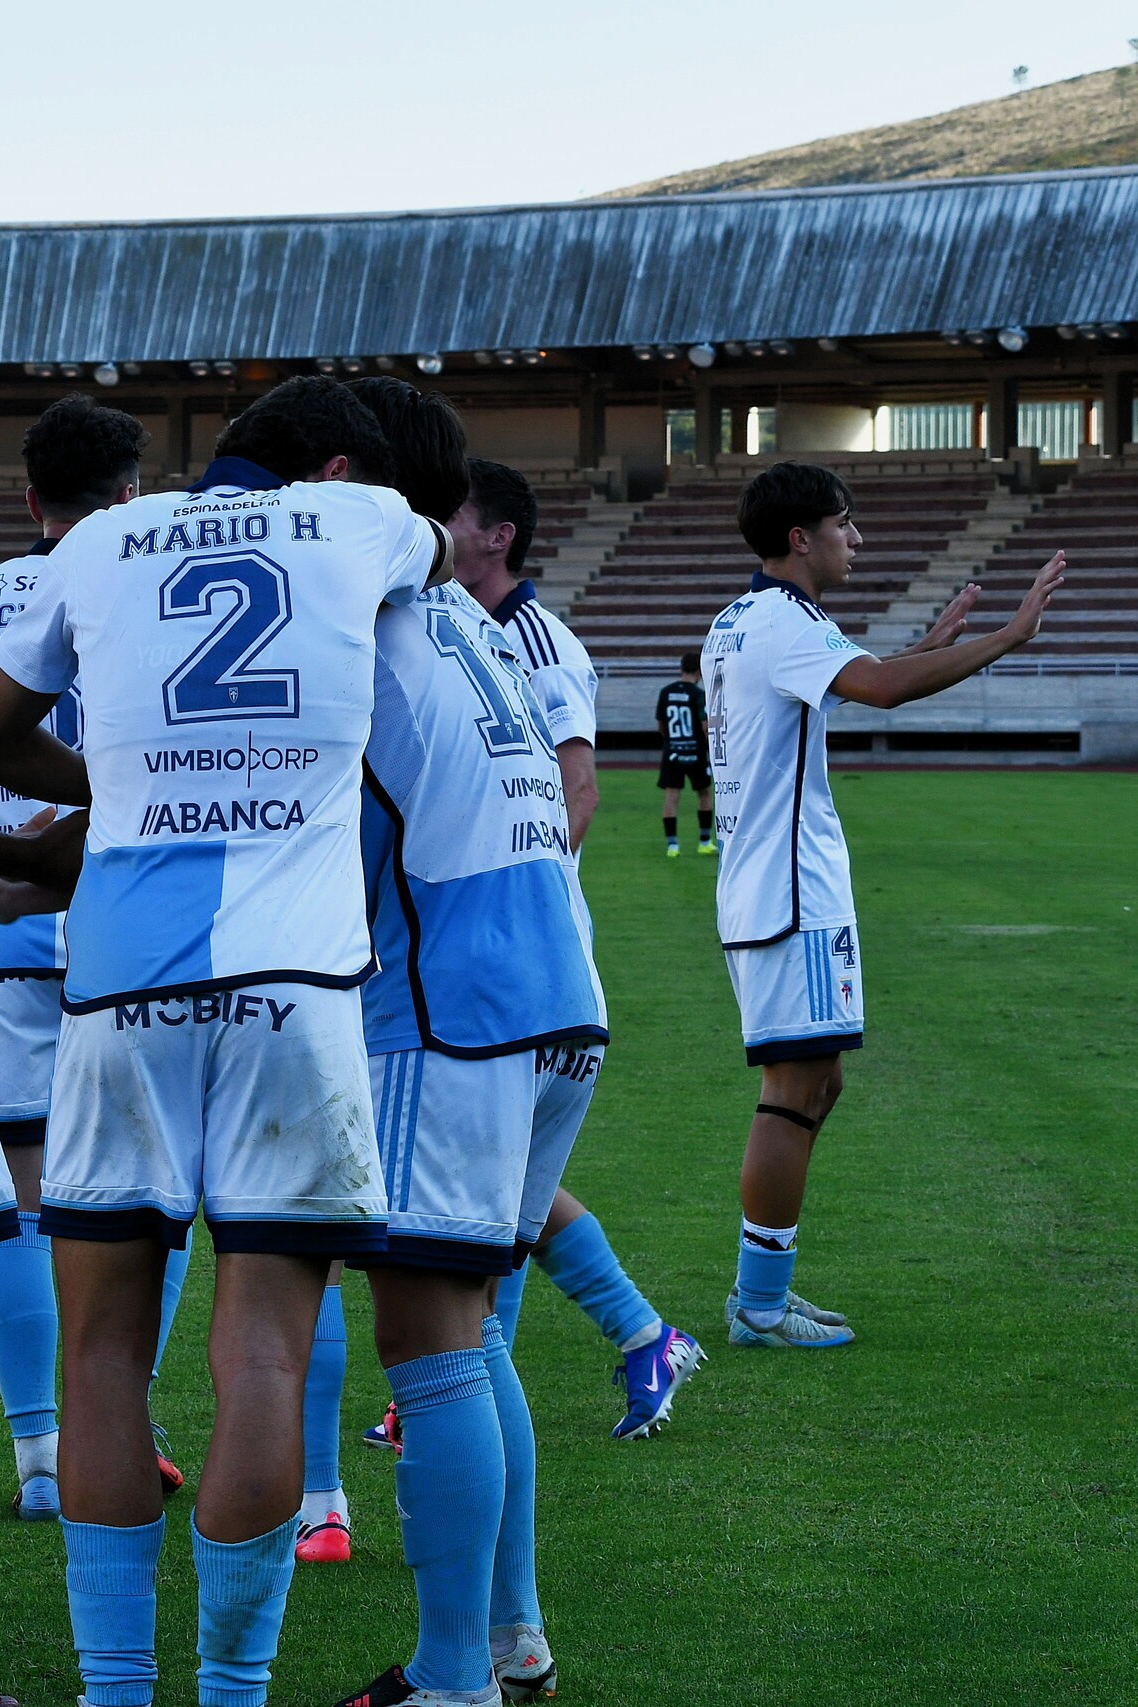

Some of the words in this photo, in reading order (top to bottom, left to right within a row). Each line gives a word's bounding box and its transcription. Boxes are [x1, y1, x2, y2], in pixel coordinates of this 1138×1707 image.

[118, 512, 270, 561] MARIO
[290, 511, 332, 542] H.
[159, 549, 301, 726] 2
[667, 705, 693, 738] 20
[144, 741, 319, 779] VIMBIOCORP
[831, 926, 856, 969] 4
